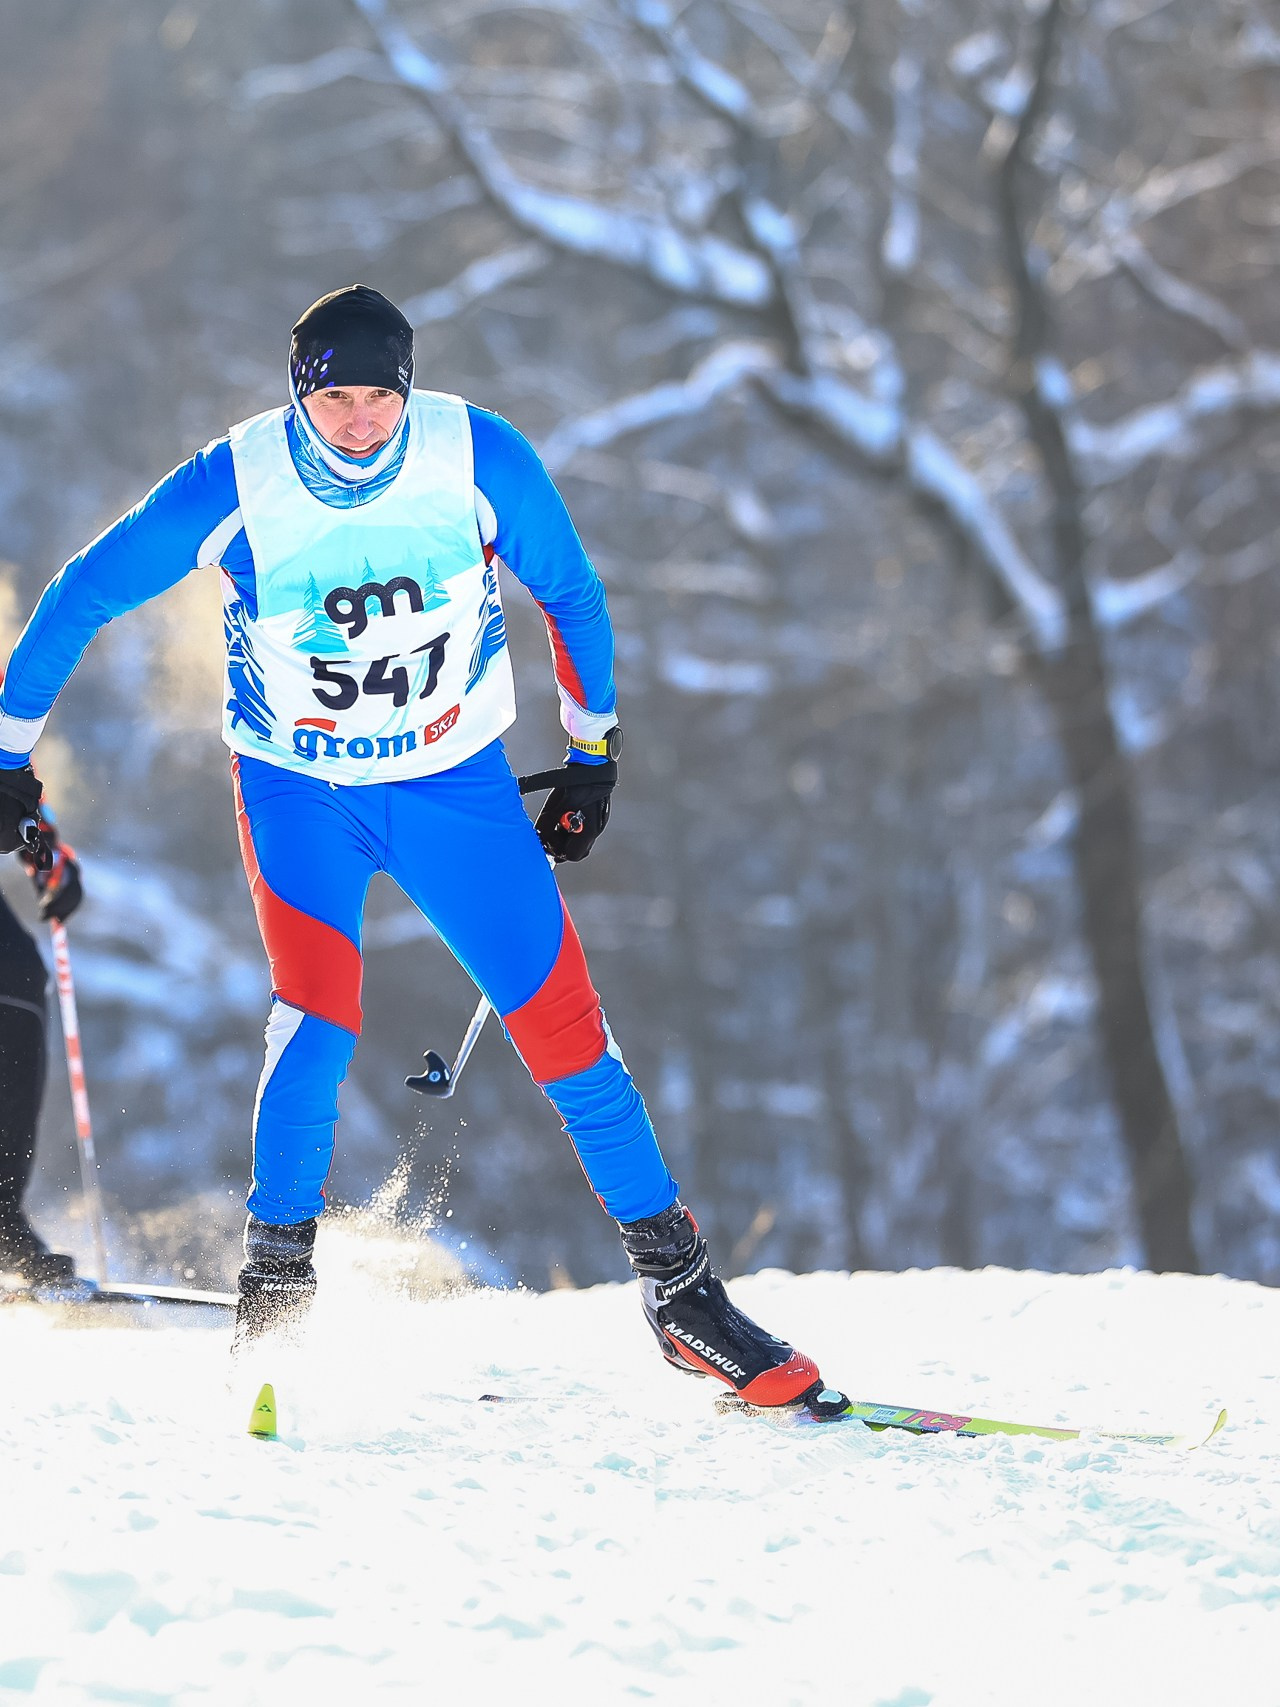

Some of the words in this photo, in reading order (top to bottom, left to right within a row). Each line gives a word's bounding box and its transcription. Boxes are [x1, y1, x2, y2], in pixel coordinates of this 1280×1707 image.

[324, 576, 424, 639] gm
[310, 632, 450, 710] 547
[293, 728, 417, 761] grom
[430, 712, 455, 739] SKI
[665, 1322, 746, 1378] MADSHUS
